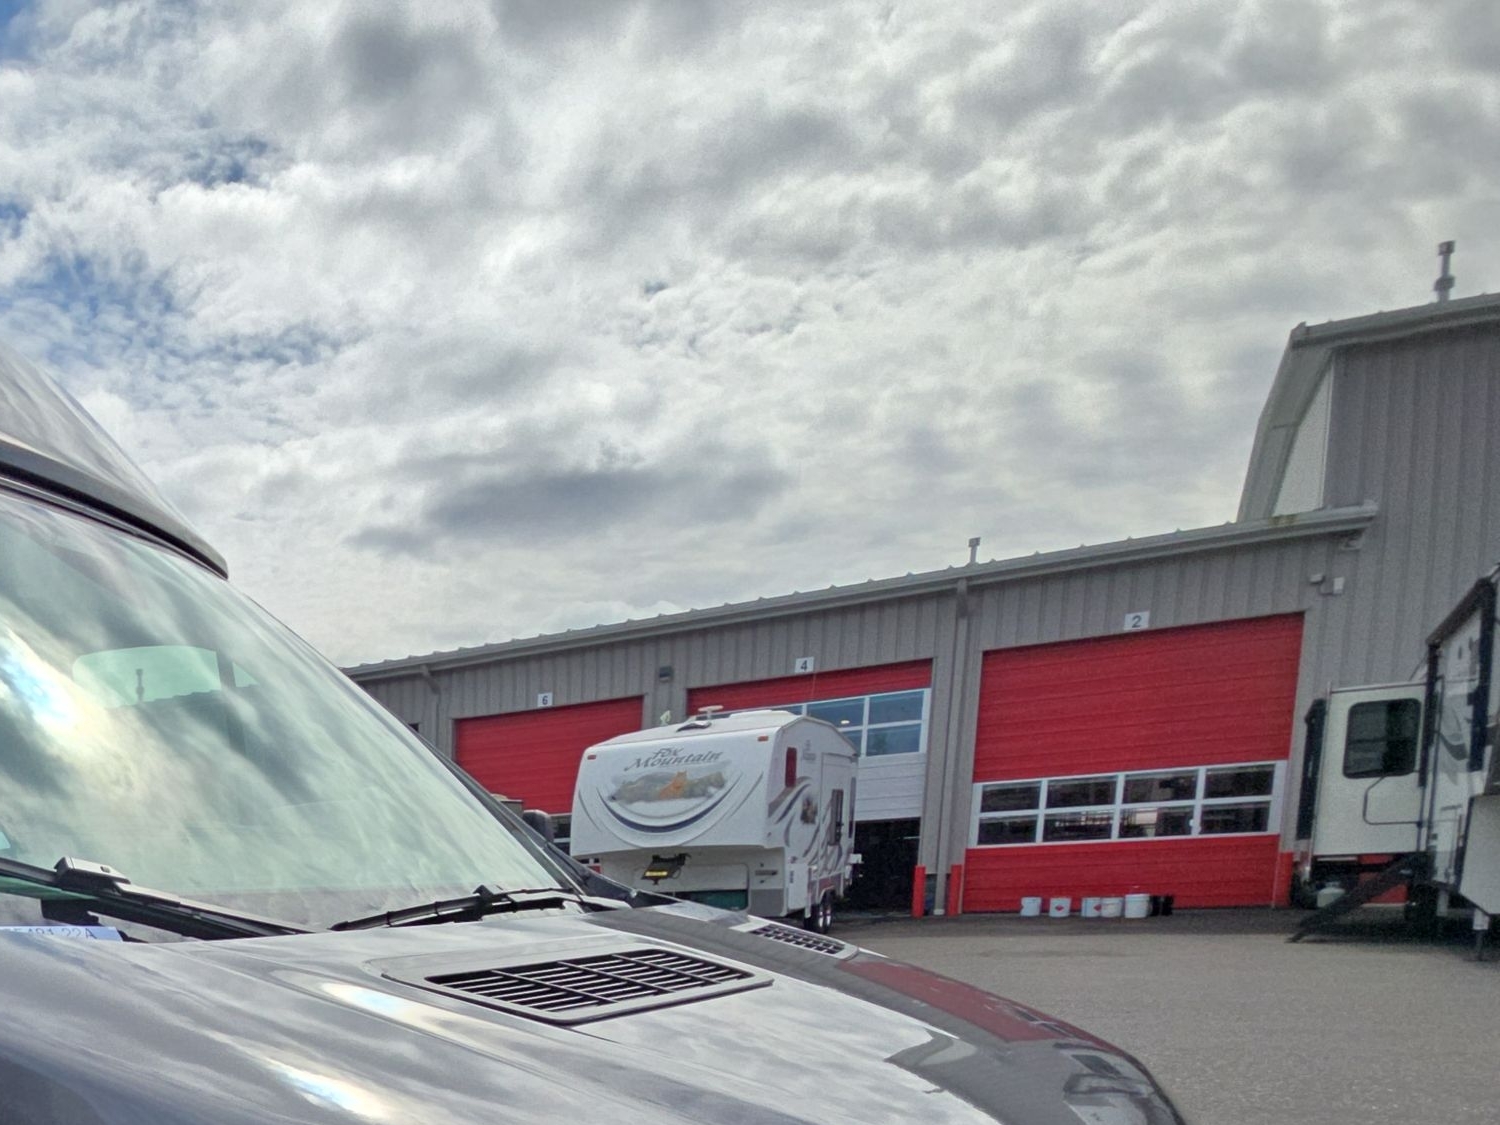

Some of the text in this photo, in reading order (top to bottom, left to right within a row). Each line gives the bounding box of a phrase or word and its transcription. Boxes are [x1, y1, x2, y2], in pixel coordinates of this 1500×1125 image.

[1131, 614, 1142, 629] 2
[800, 659, 808, 671] 4
[542, 695, 549, 706] 6
[623, 750, 724, 772] Mountain
